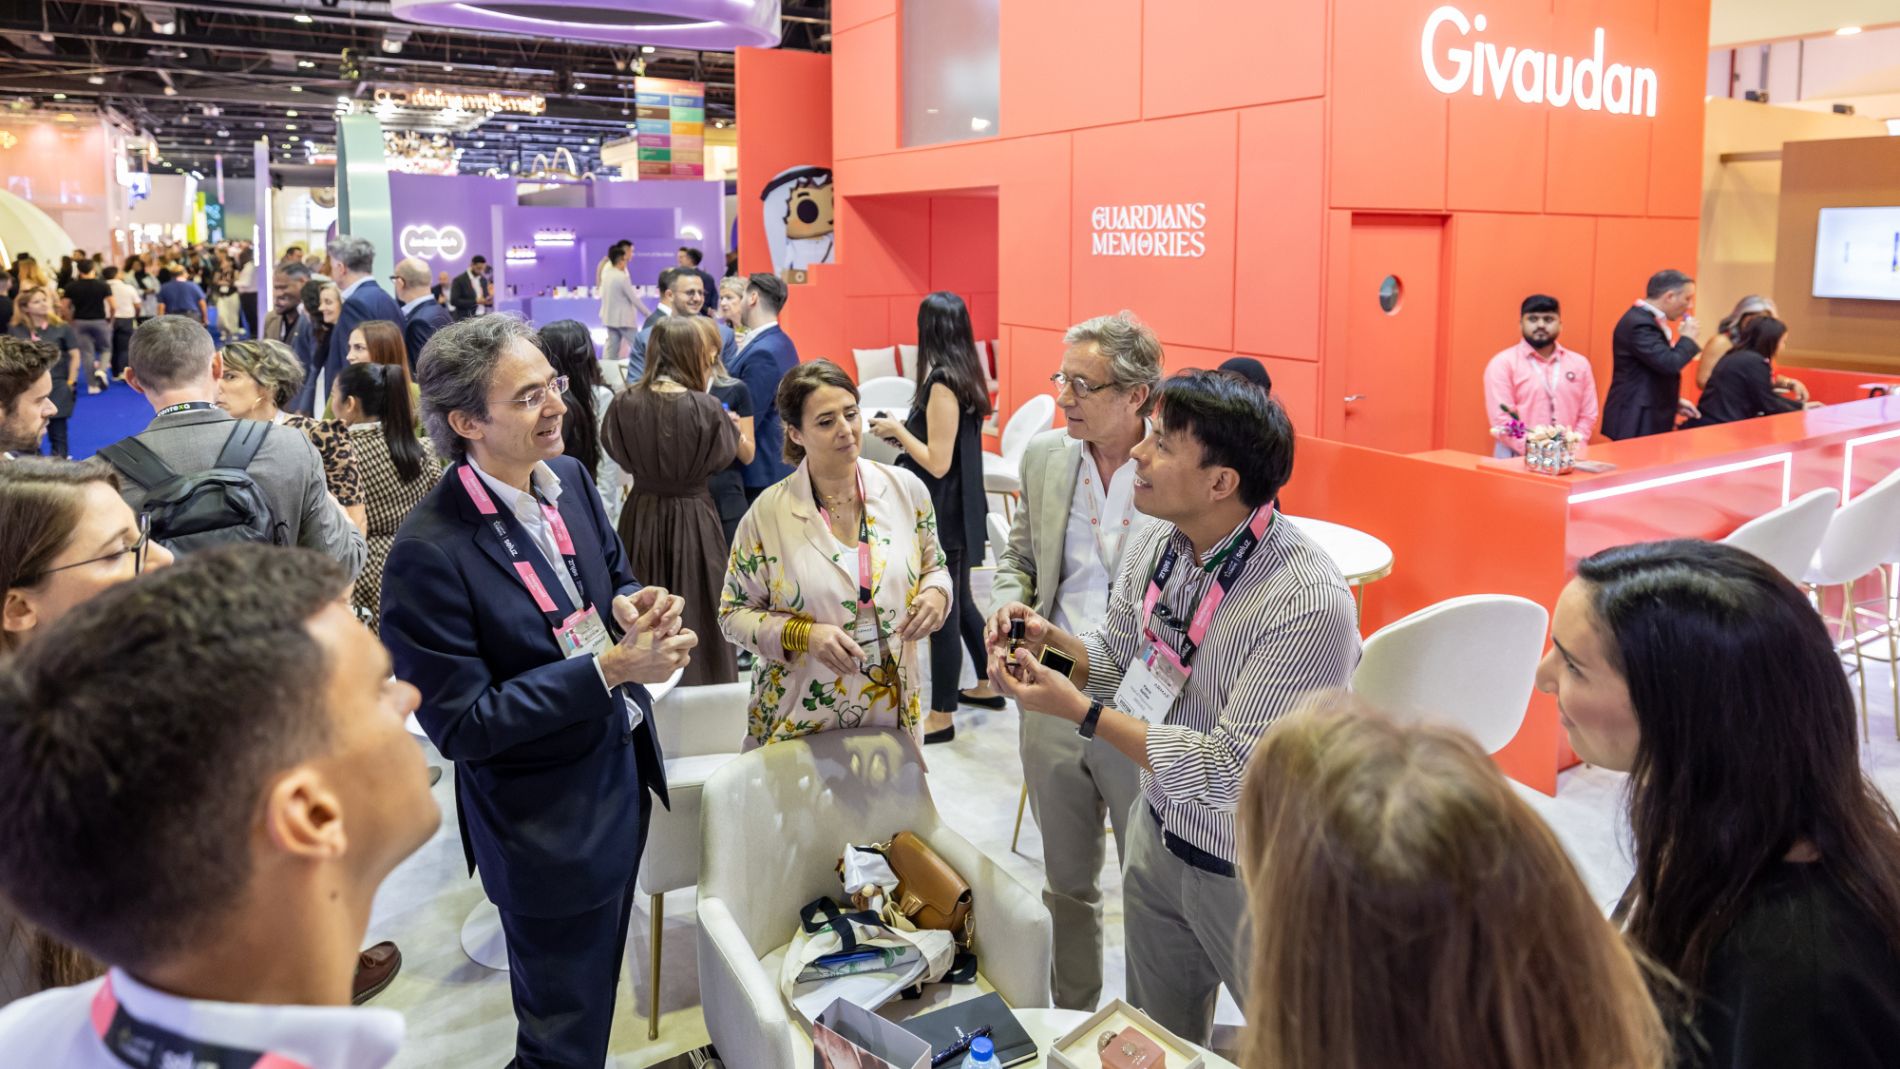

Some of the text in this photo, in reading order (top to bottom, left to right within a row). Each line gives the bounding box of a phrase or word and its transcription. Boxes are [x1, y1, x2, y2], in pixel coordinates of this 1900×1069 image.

[1421, 6, 1658, 117] Givaudan
[1091, 202, 1206, 230] GUARDIANS
[1091, 231, 1206, 258] MEMORIES
[1235, 539, 1252, 559] seluz
